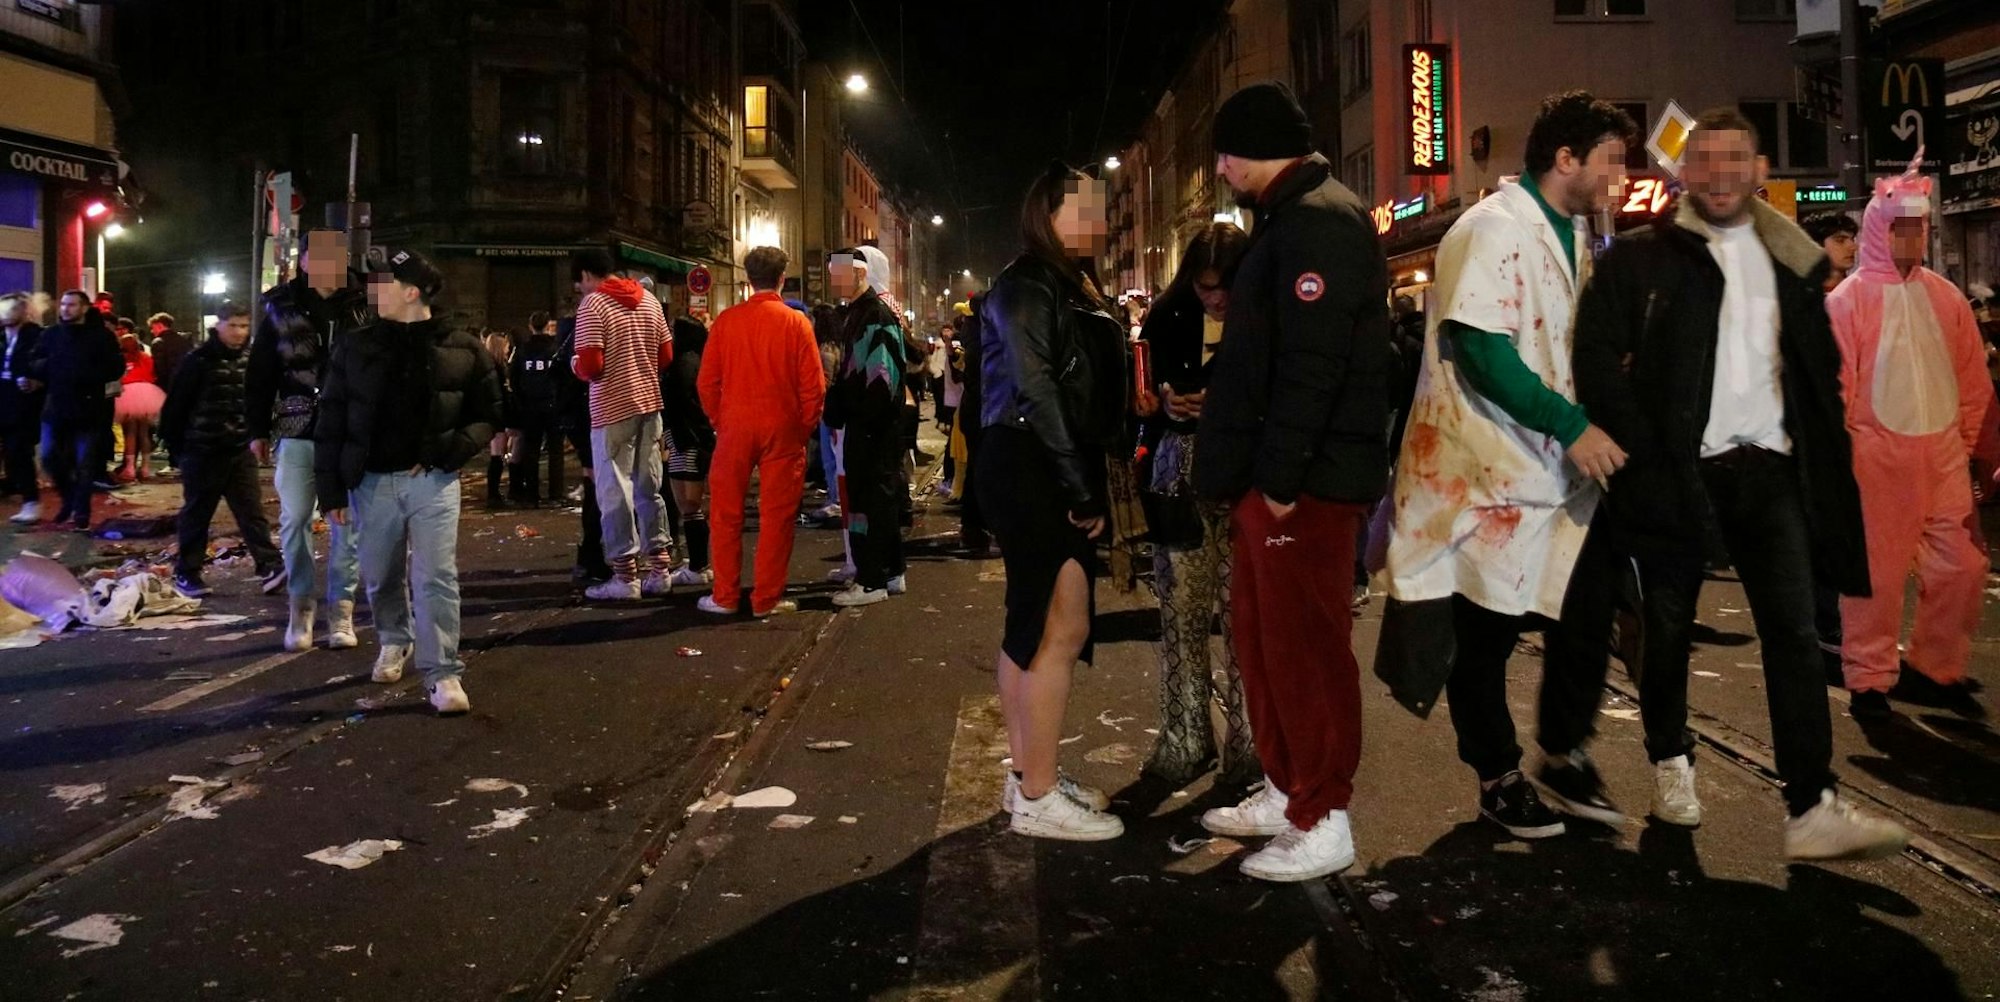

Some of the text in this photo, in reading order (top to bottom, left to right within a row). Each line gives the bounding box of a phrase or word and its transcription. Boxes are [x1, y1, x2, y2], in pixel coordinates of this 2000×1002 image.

[1432, 59, 1443, 112] RESTAURANT
[1411, 49, 1432, 168] RENDEZVOUS
[1433, 117, 1444, 134] BAR
[10, 151, 89, 182] COCKTAIL
[525, 360, 552, 370] FBI
